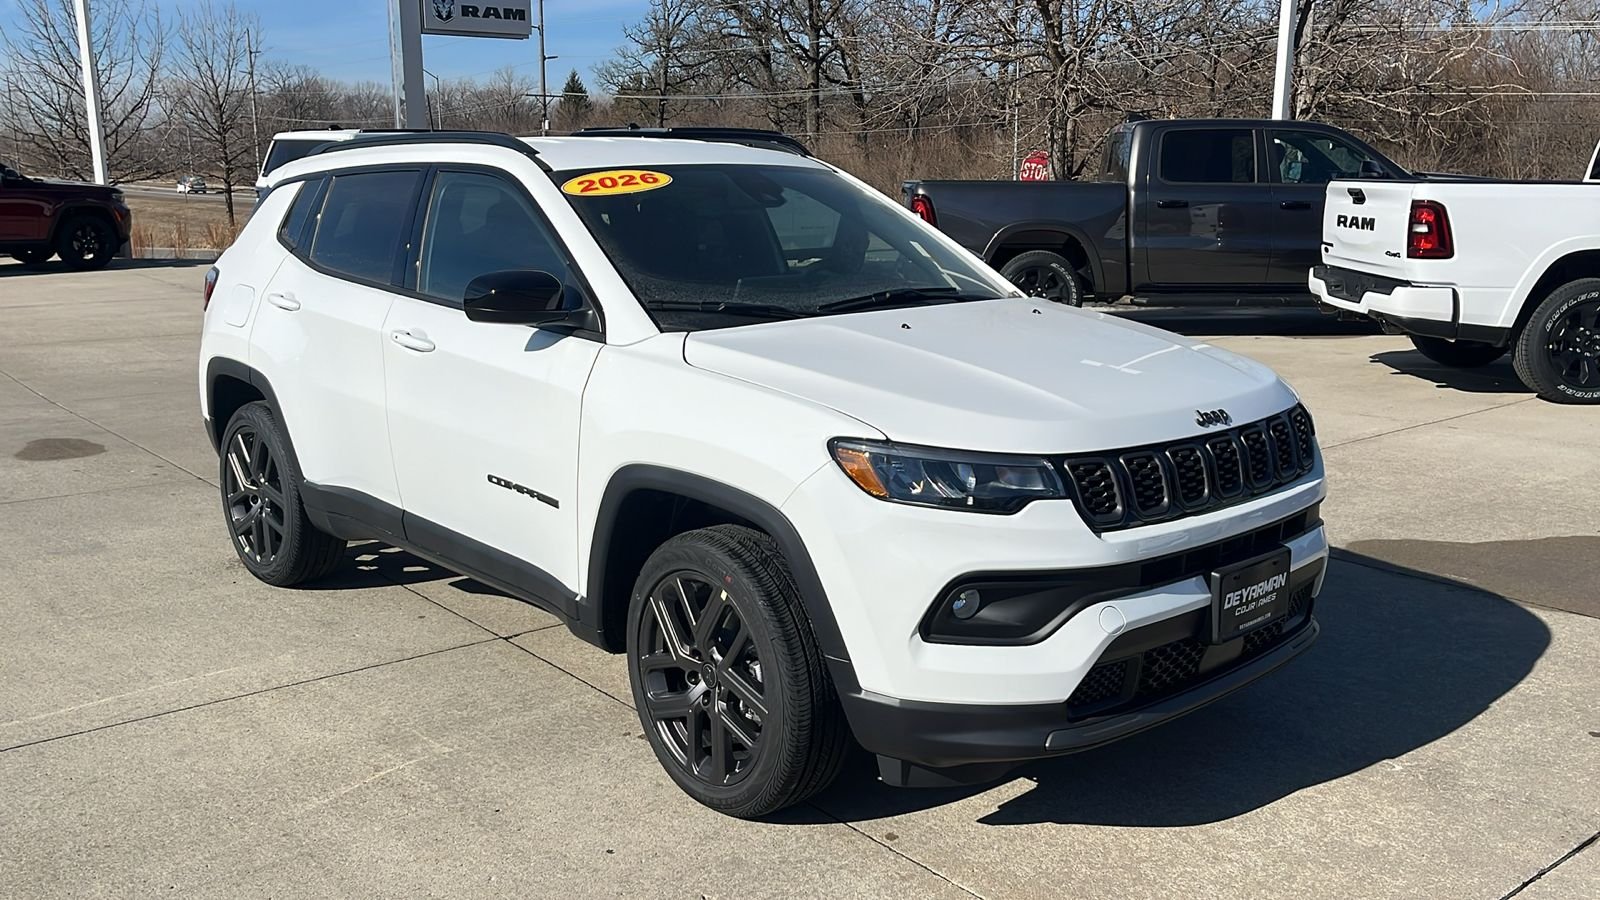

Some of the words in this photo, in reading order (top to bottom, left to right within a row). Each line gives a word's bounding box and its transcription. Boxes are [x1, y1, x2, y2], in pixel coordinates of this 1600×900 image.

[461, 5, 526, 21] RAM
[577, 173, 659, 193] 2026
[1337, 214, 1376, 231] RAM
[1195, 408, 1232, 428] Jeep
[487, 474, 560, 510] COMPASS
[1223, 572, 1287, 610] DEYARMAN
